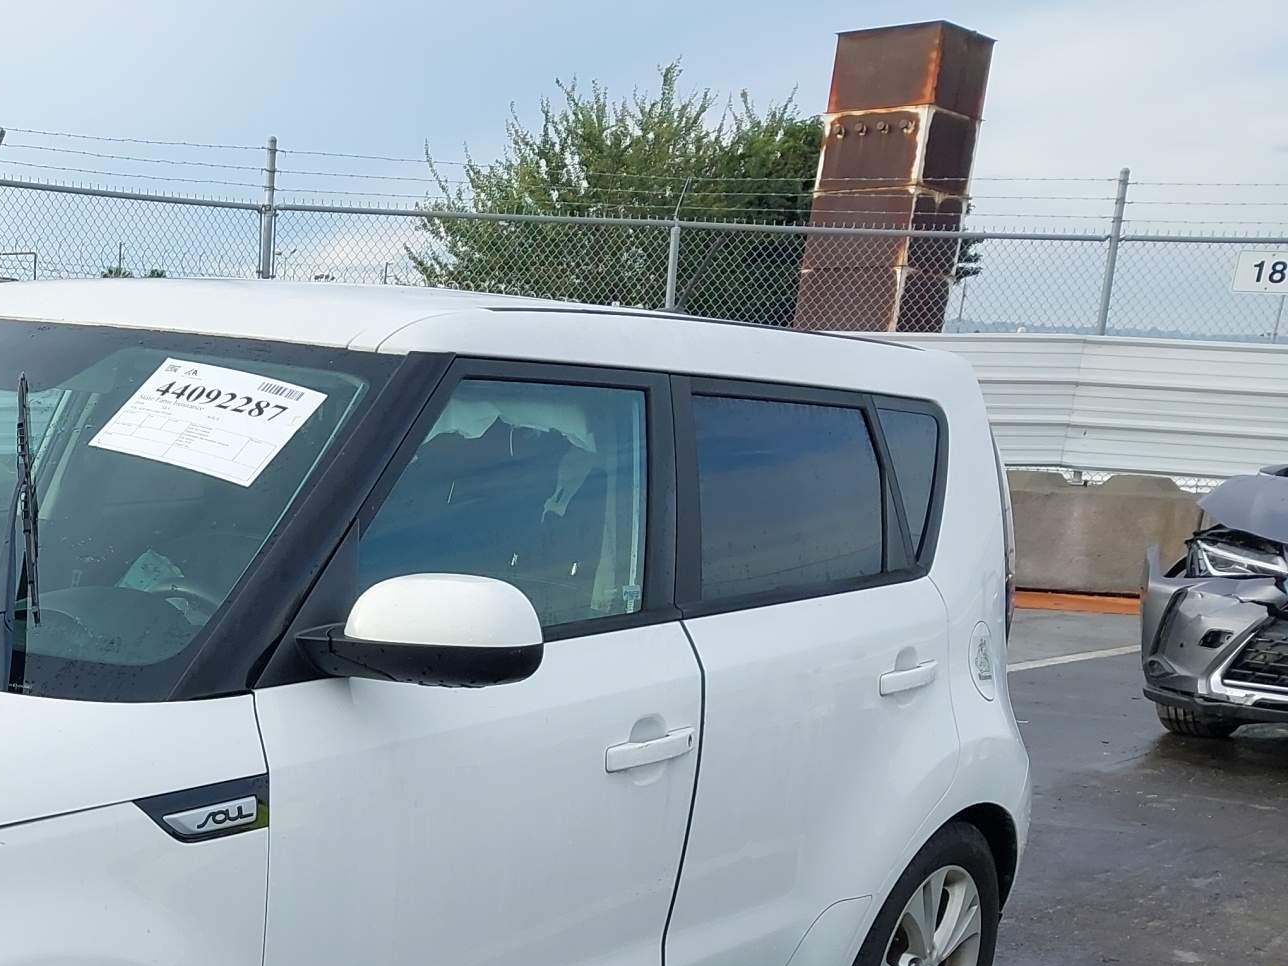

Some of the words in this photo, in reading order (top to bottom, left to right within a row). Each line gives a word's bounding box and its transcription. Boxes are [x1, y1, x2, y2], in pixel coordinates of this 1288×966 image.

[1253, 260, 1288, 284] 18
[156, 381, 288, 421] 44092287
[196, 805, 254, 829] SOUL
